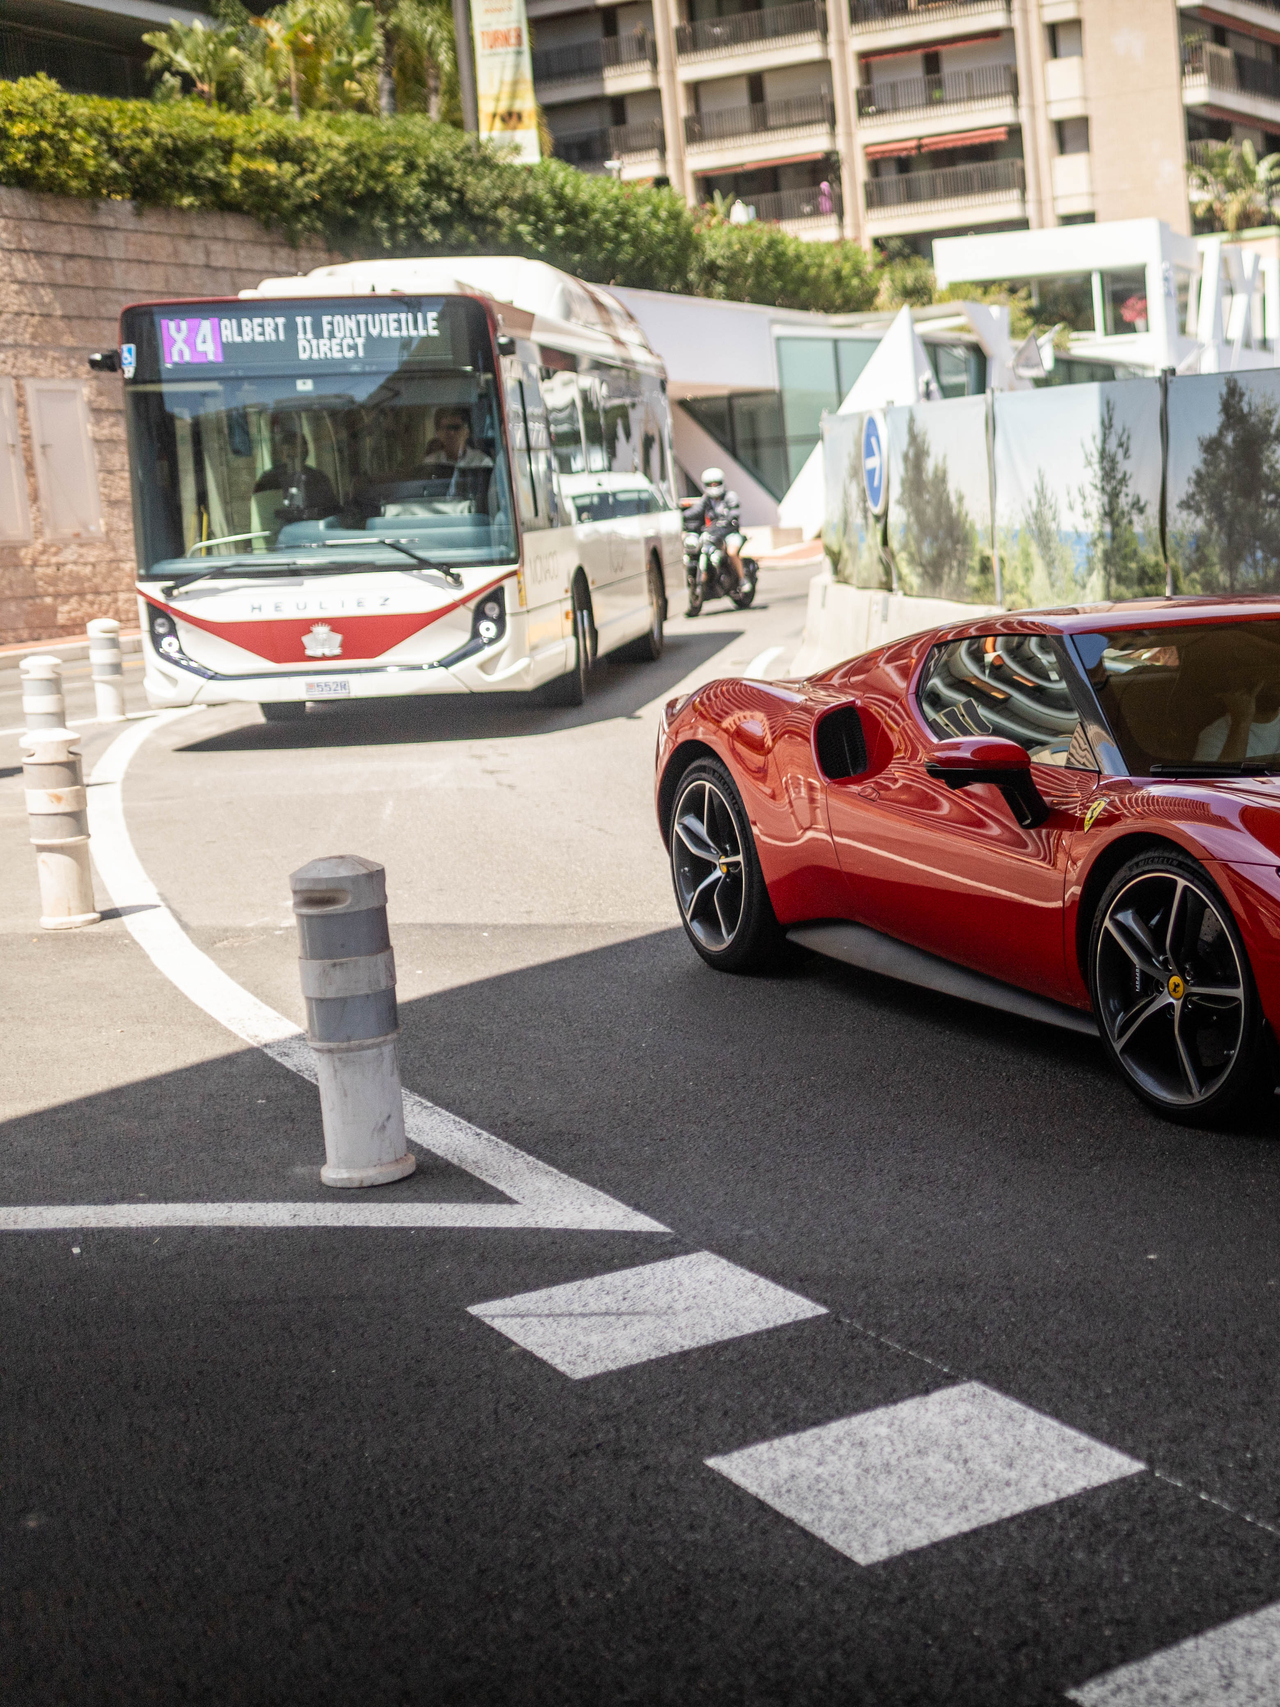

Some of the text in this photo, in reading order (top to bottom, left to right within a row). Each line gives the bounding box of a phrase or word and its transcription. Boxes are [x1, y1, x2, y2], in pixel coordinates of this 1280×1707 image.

[221, 311, 440, 343] ALBERT II FONTVIEILLE
[167, 319, 216, 363] X4
[298, 338, 366, 361] DIRECT
[251, 597, 390, 613] HEULIEZ
[1138, 857, 1178, 867] MICHELIN
